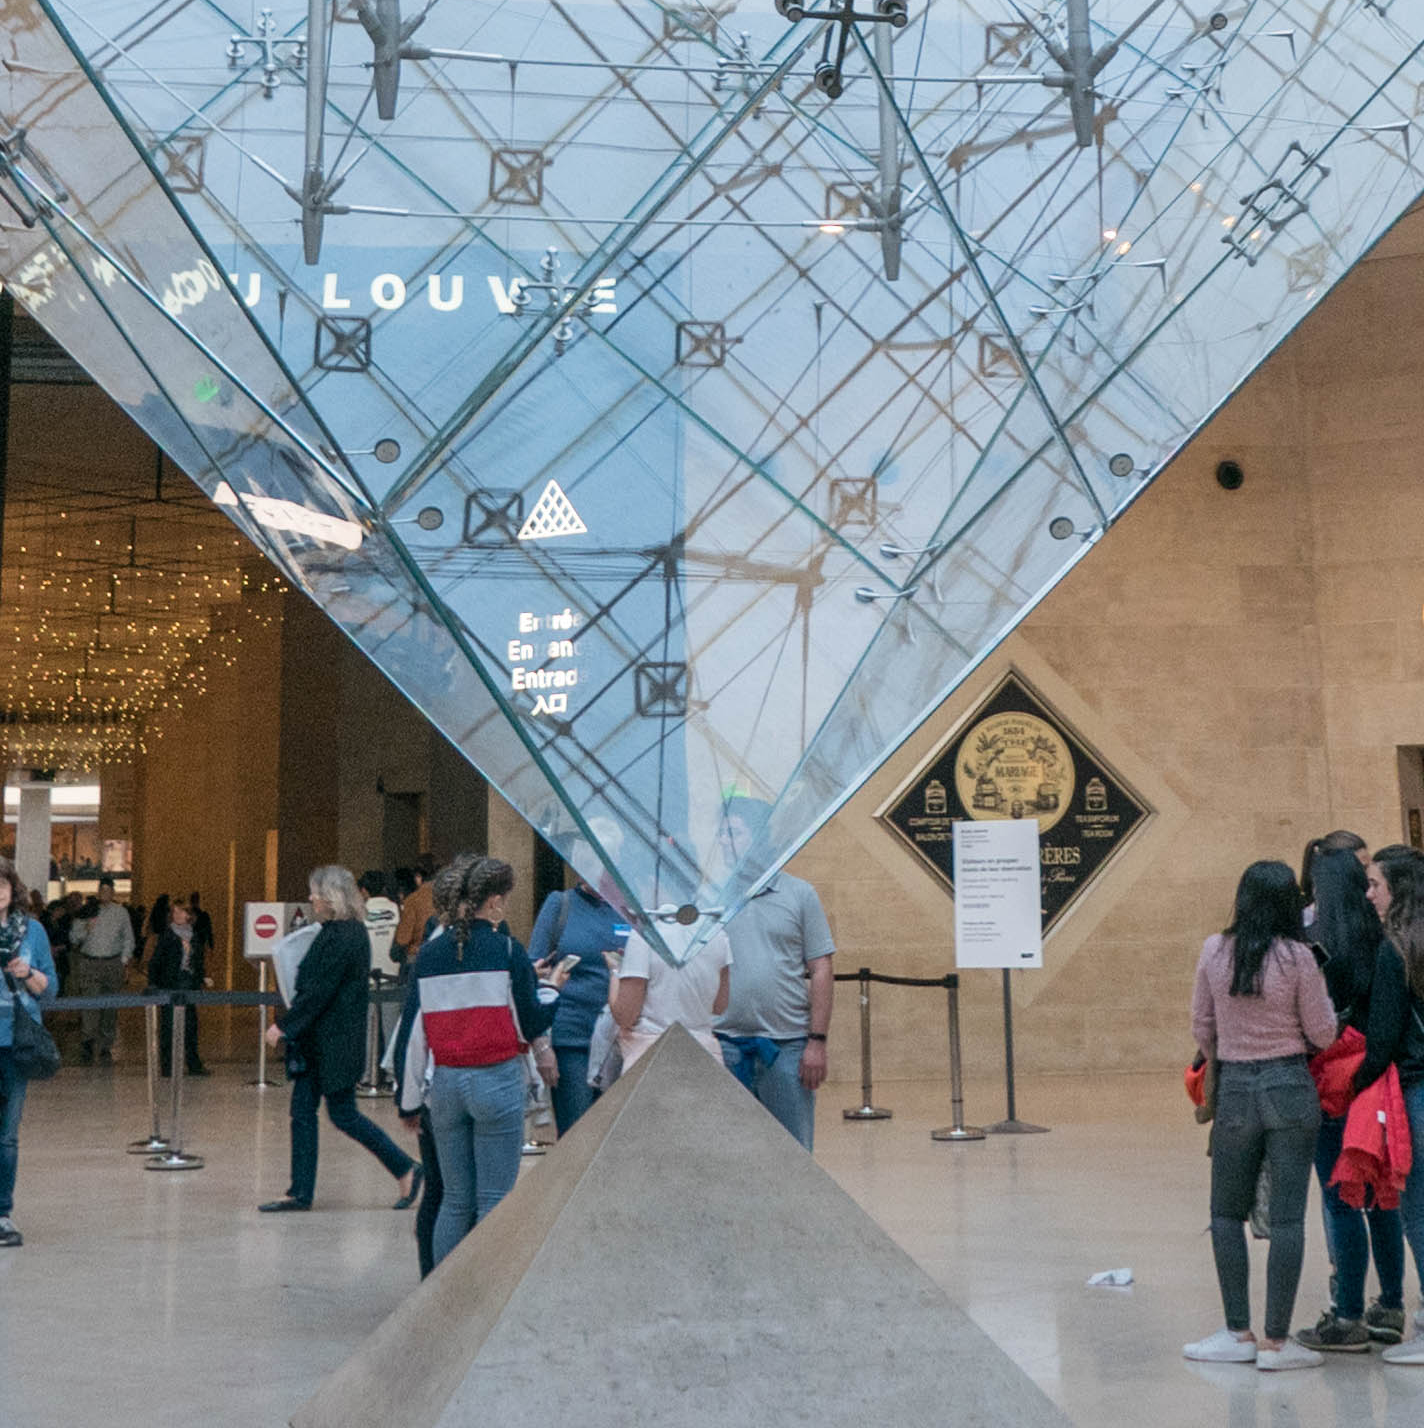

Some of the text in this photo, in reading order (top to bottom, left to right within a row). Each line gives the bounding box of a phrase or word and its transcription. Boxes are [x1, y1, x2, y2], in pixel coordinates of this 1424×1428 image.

[322, 272, 618, 314] LOUVE
[512, 667, 578, 690] Entrad
[531, 693, 568, 716] 入口
[1039, 842, 1081, 866] RÈRES
